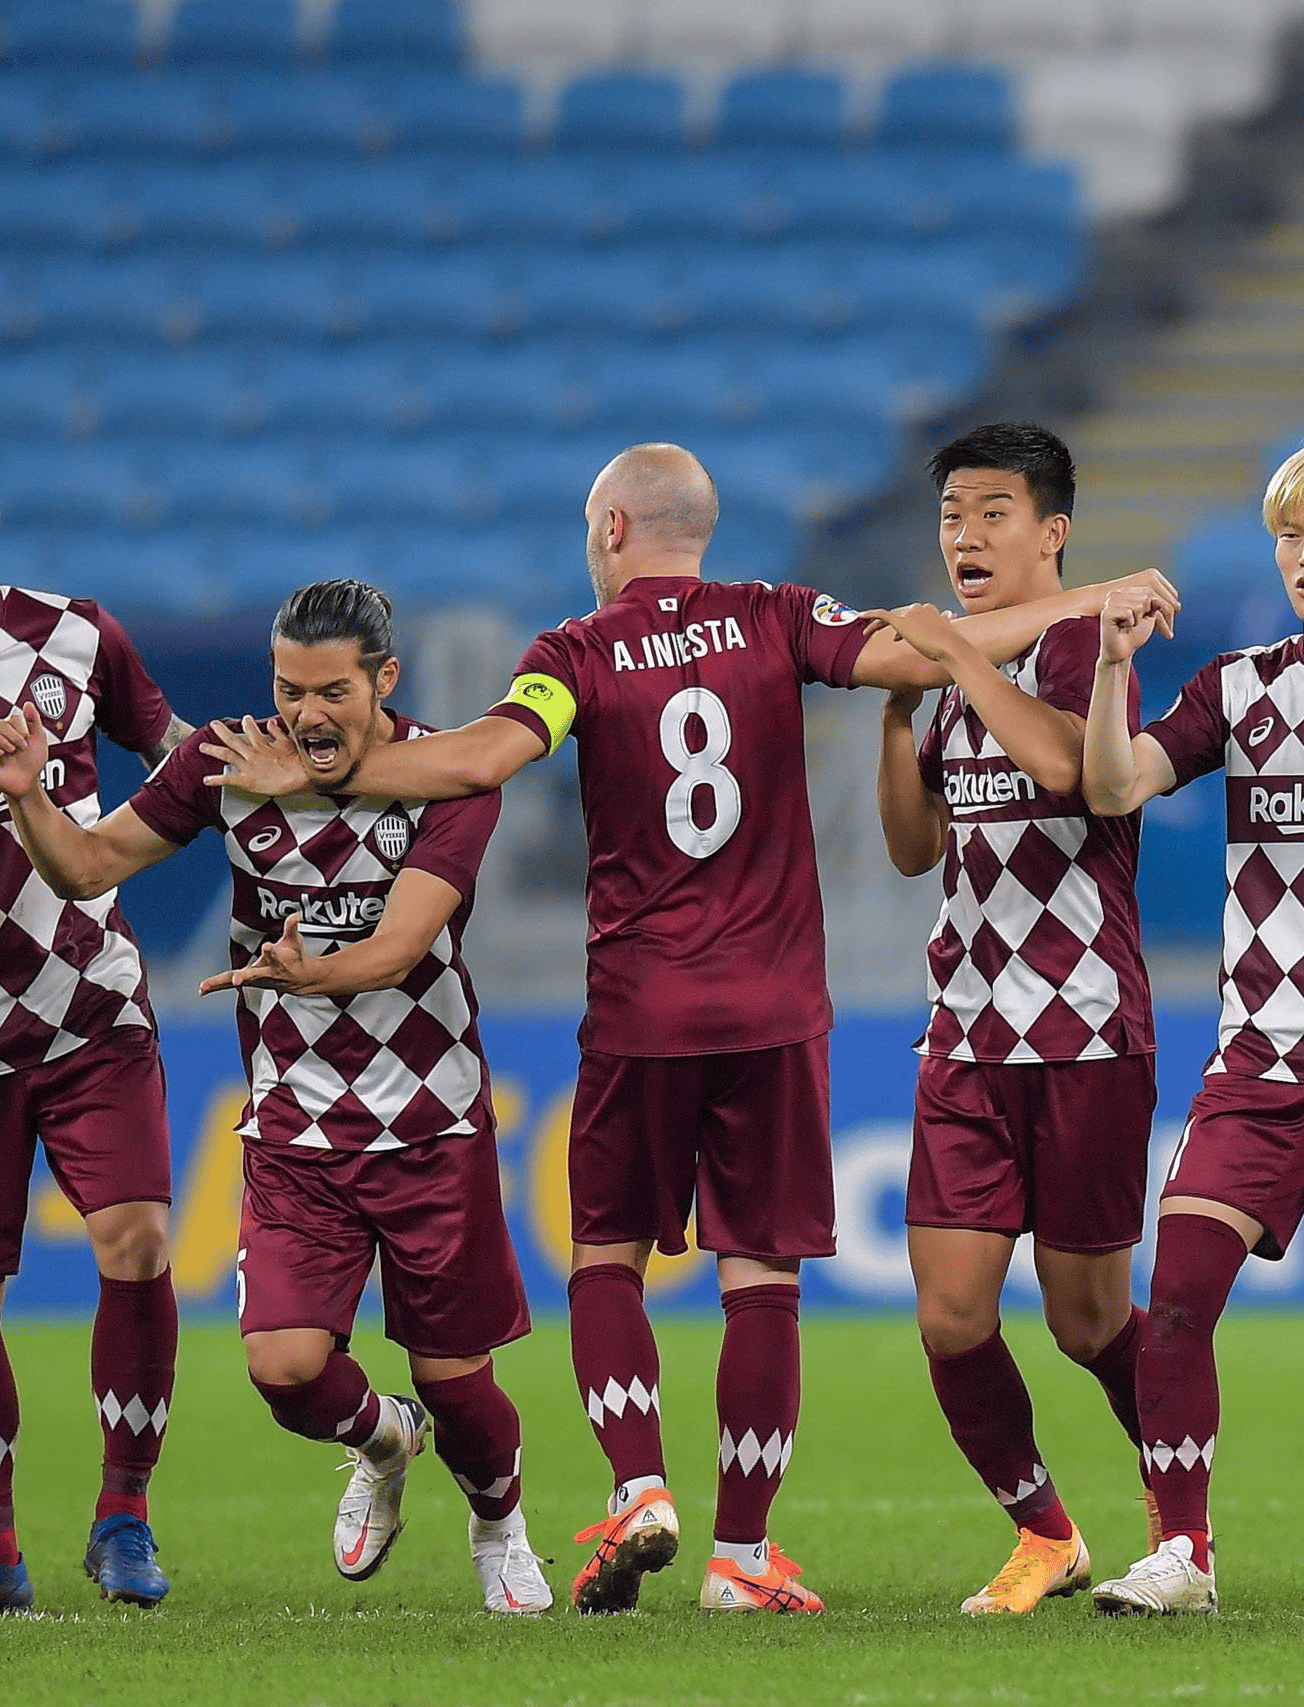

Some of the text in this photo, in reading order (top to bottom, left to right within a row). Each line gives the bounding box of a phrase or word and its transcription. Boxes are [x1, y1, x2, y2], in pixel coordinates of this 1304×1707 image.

[613, 616, 747, 672] A.INIESTA
[660, 687, 741, 859] 8
[257, 886, 388, 926] Rakute
